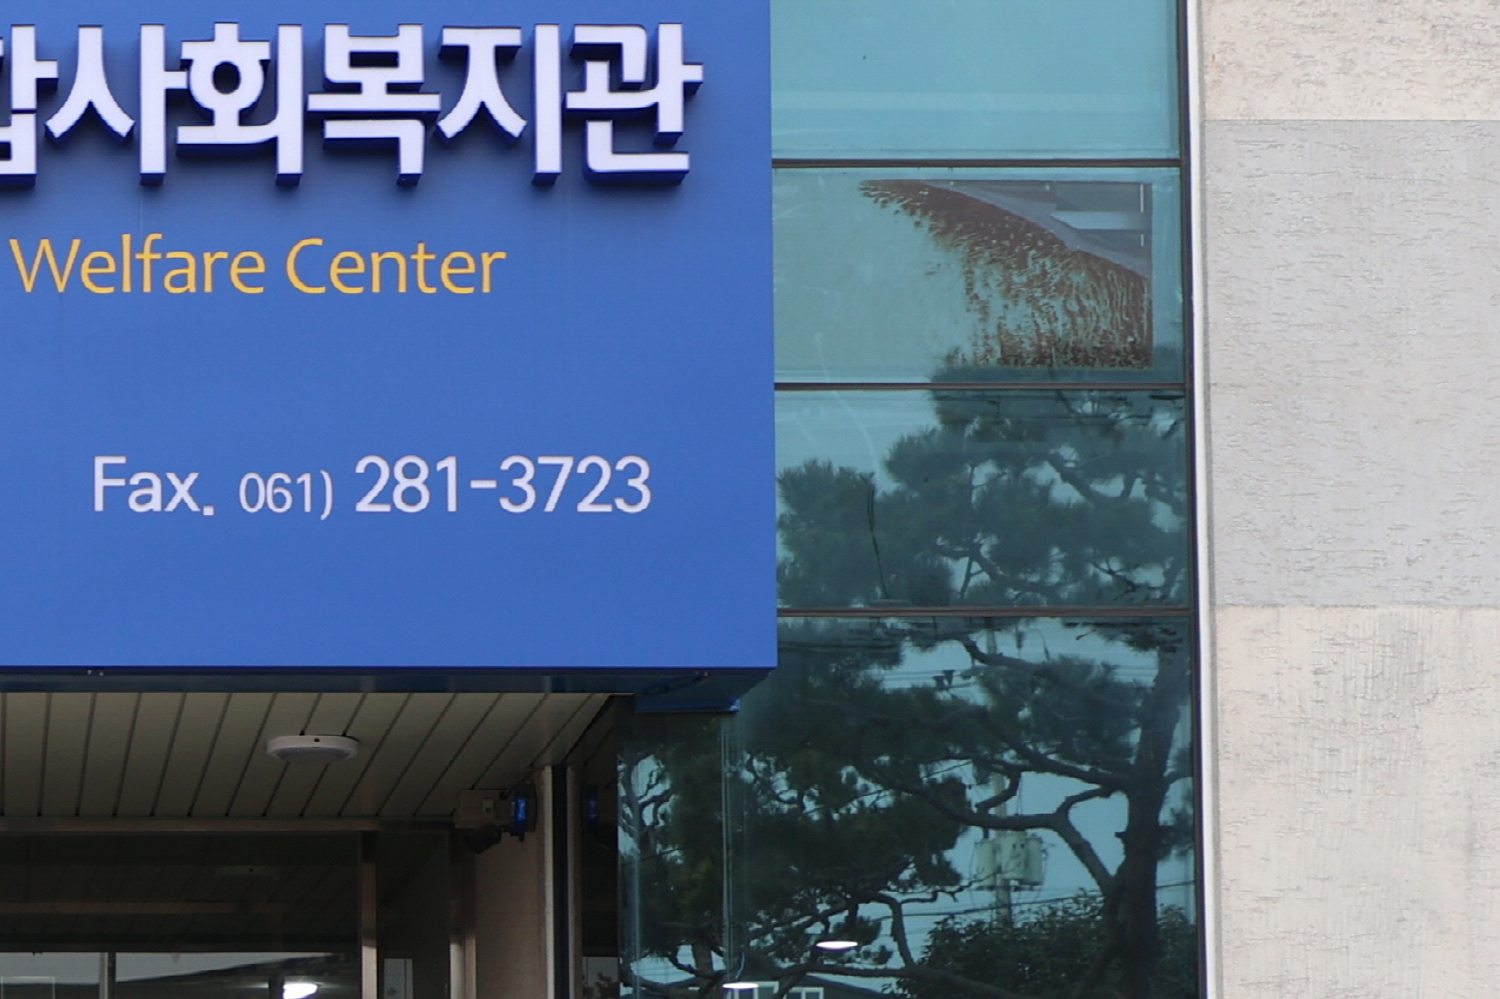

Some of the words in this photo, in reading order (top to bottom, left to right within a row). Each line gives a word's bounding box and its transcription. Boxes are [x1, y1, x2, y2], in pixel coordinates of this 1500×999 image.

[10, 233, 266, 295] Welfare
[286, 237, 506, 295] Center
[94, 455, 214, 516] Fax.
[239, 470, 333, 520] 061)
[355, 454, 651, 514] 281-3723
